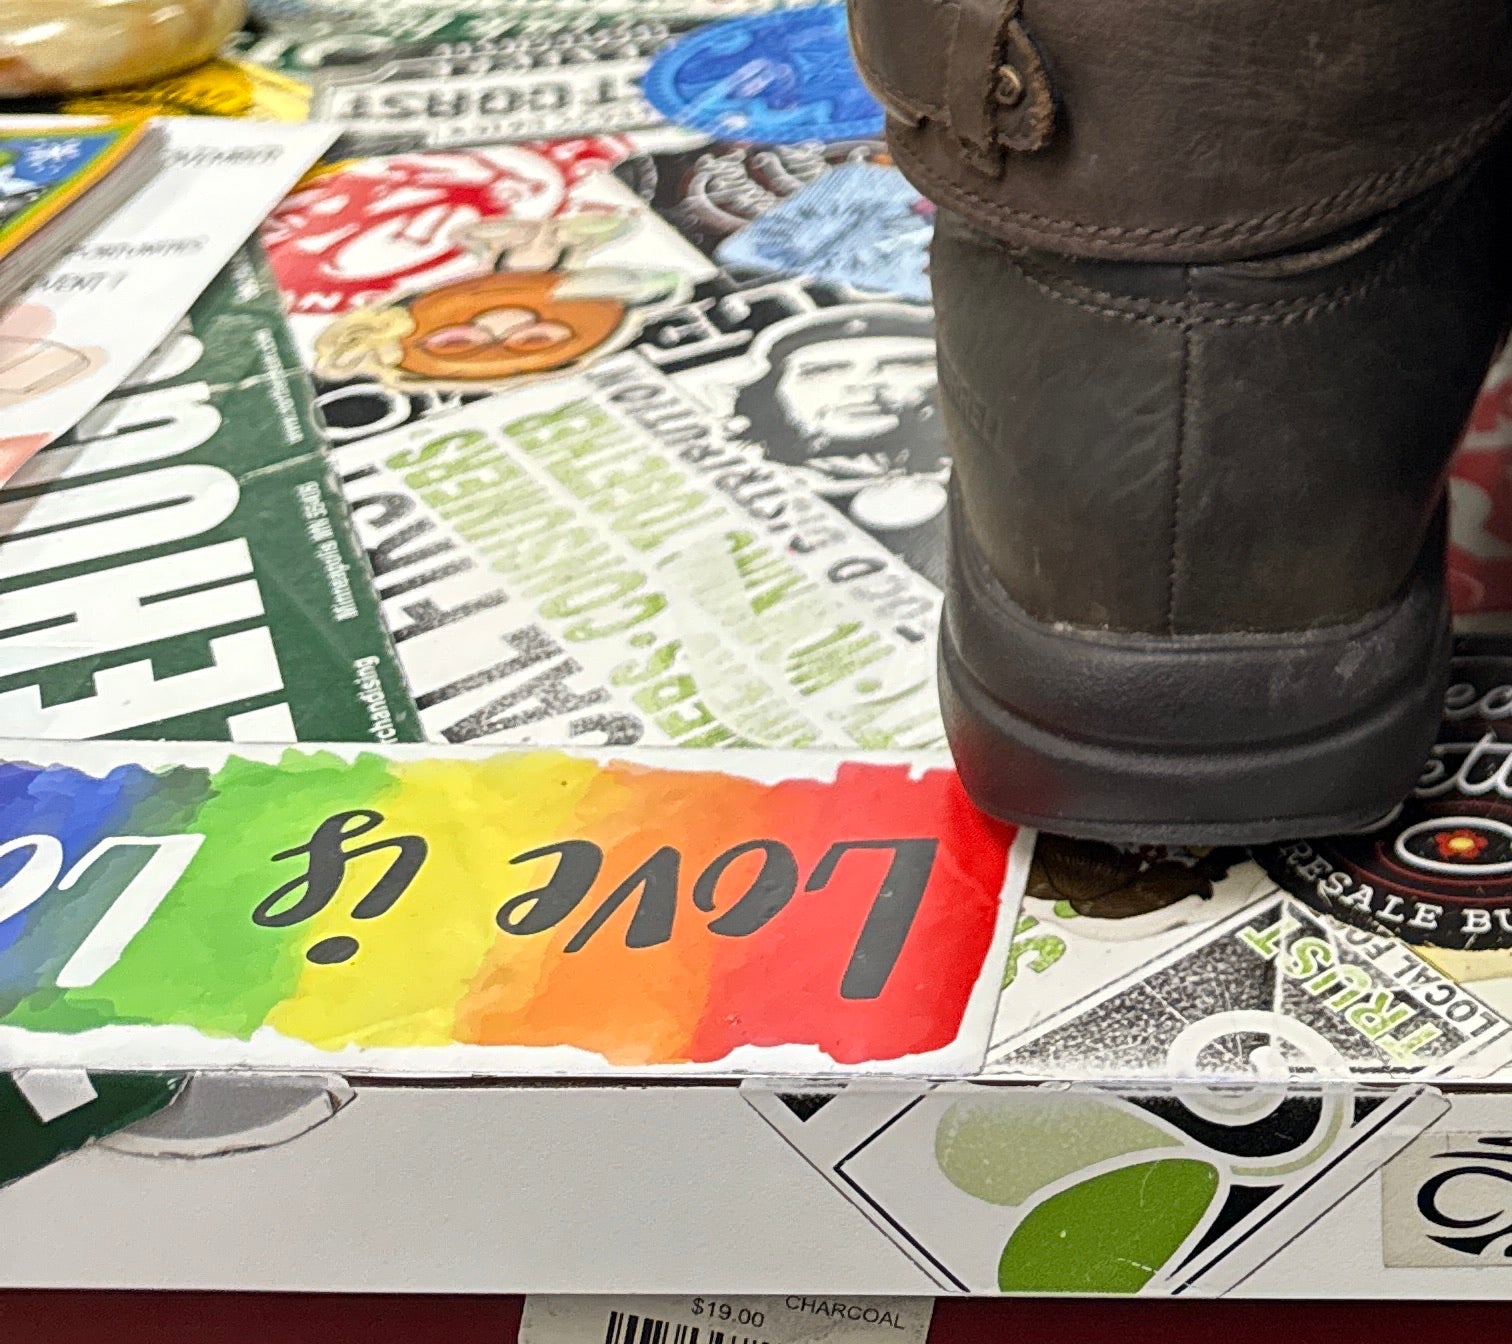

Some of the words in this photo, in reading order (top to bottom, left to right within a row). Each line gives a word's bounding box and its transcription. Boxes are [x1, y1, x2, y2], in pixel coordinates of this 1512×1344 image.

[583, 360, 849, 557] DISTRIBUTION
[314, 538, 359, 621] Minneapolis
[353, 655, 396, 744] rchandising
[250, 809, 428, 965] is
[496, 837, 938, 1001] Love
[1280, 843, 1444, 931] RESALE
[1234, 915, 1442, 1058] TRUST
[1392, 955, 1500, 1039] LOCAL
[690, 1297, 766, 1329] $19.00
[784, 1294, 906, 1331] CHARCOAL
